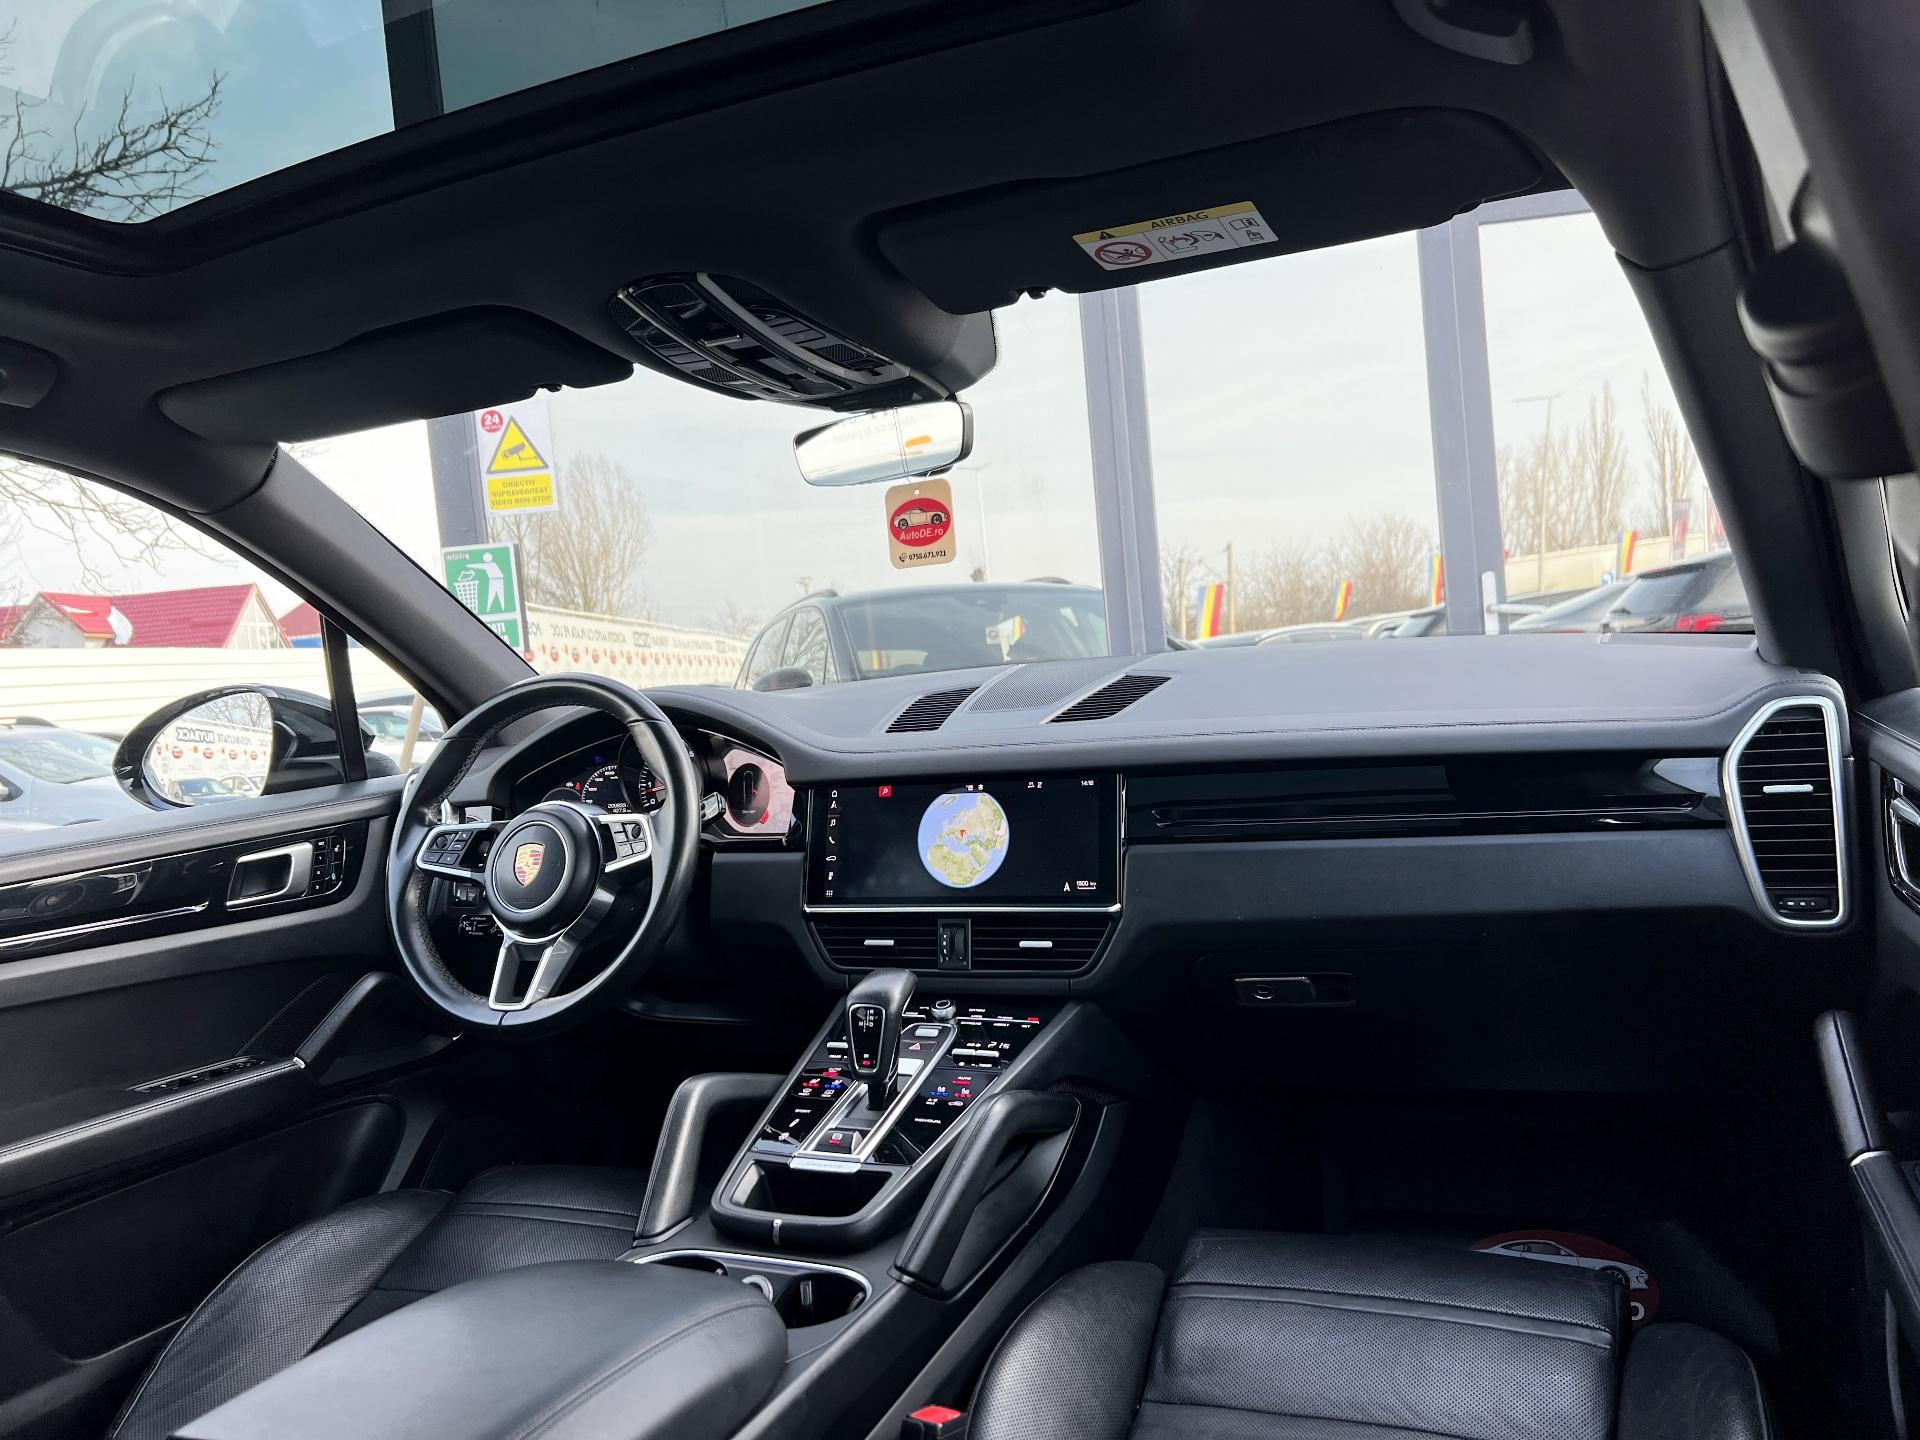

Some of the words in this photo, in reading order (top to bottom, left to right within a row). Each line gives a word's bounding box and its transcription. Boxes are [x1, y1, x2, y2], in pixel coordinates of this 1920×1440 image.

[1150, 211, 1209, 230] AIRBAG
[483, 413, 500, 426] 24
[491, 499, 513, 507] VIDEO
[899, 528, 944, 541] AutoDE.ro
